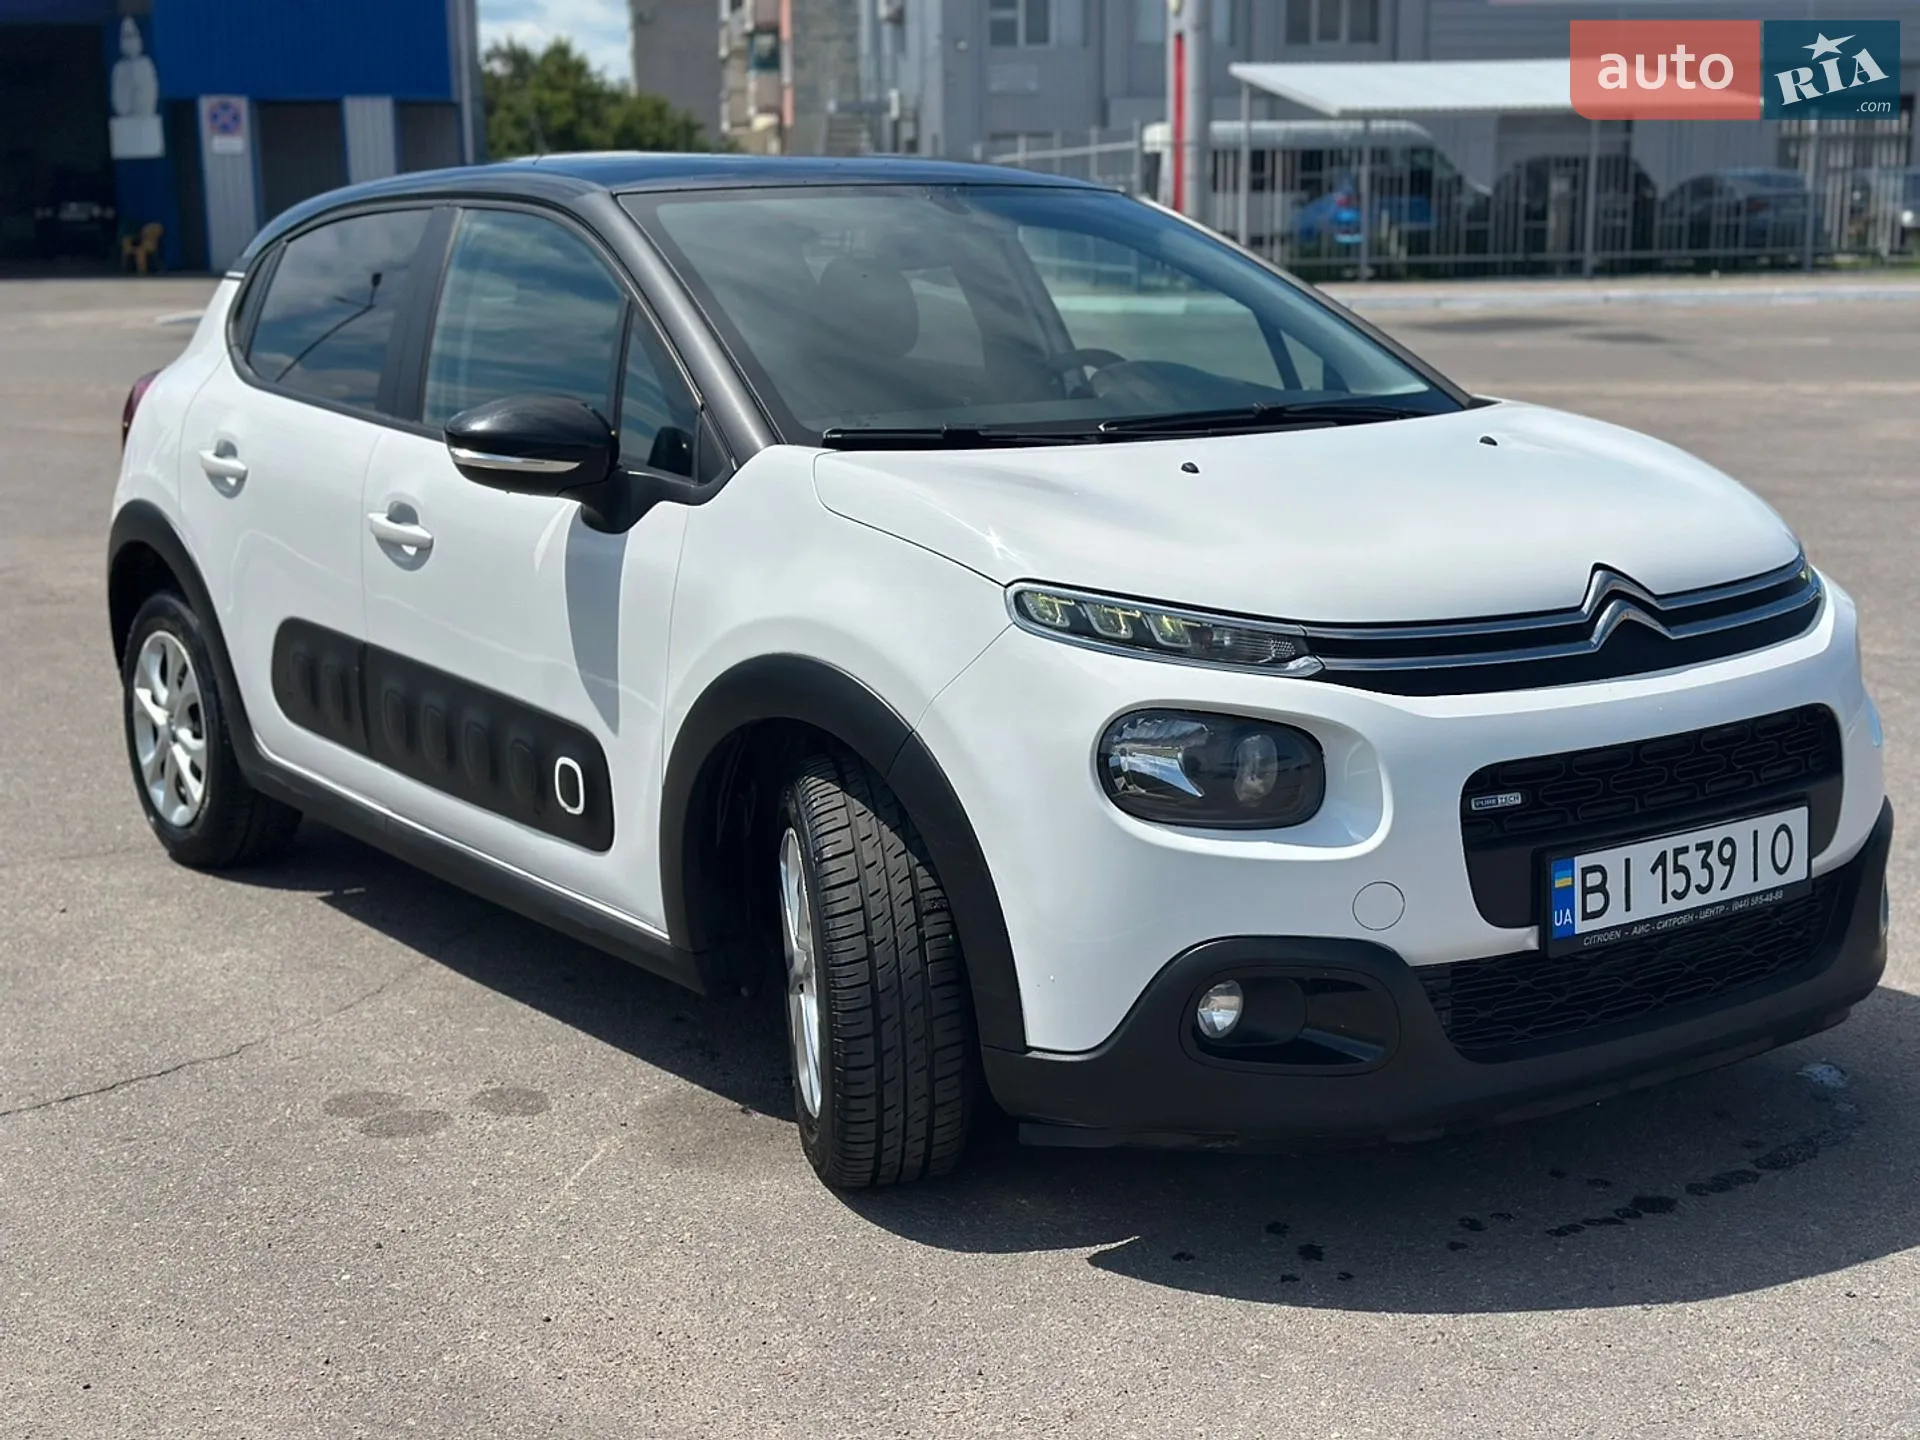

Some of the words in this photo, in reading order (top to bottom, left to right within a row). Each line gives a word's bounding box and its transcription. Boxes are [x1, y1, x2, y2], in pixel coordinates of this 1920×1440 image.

[1581, 857, 1631, 922] BI
[1650, 836, 1737, 904] 1539
[1752, 823, 1794, 882] IO
[1554, 908, 1573, 927] UA
[1583, 929, 1621, 946] CITROEN
